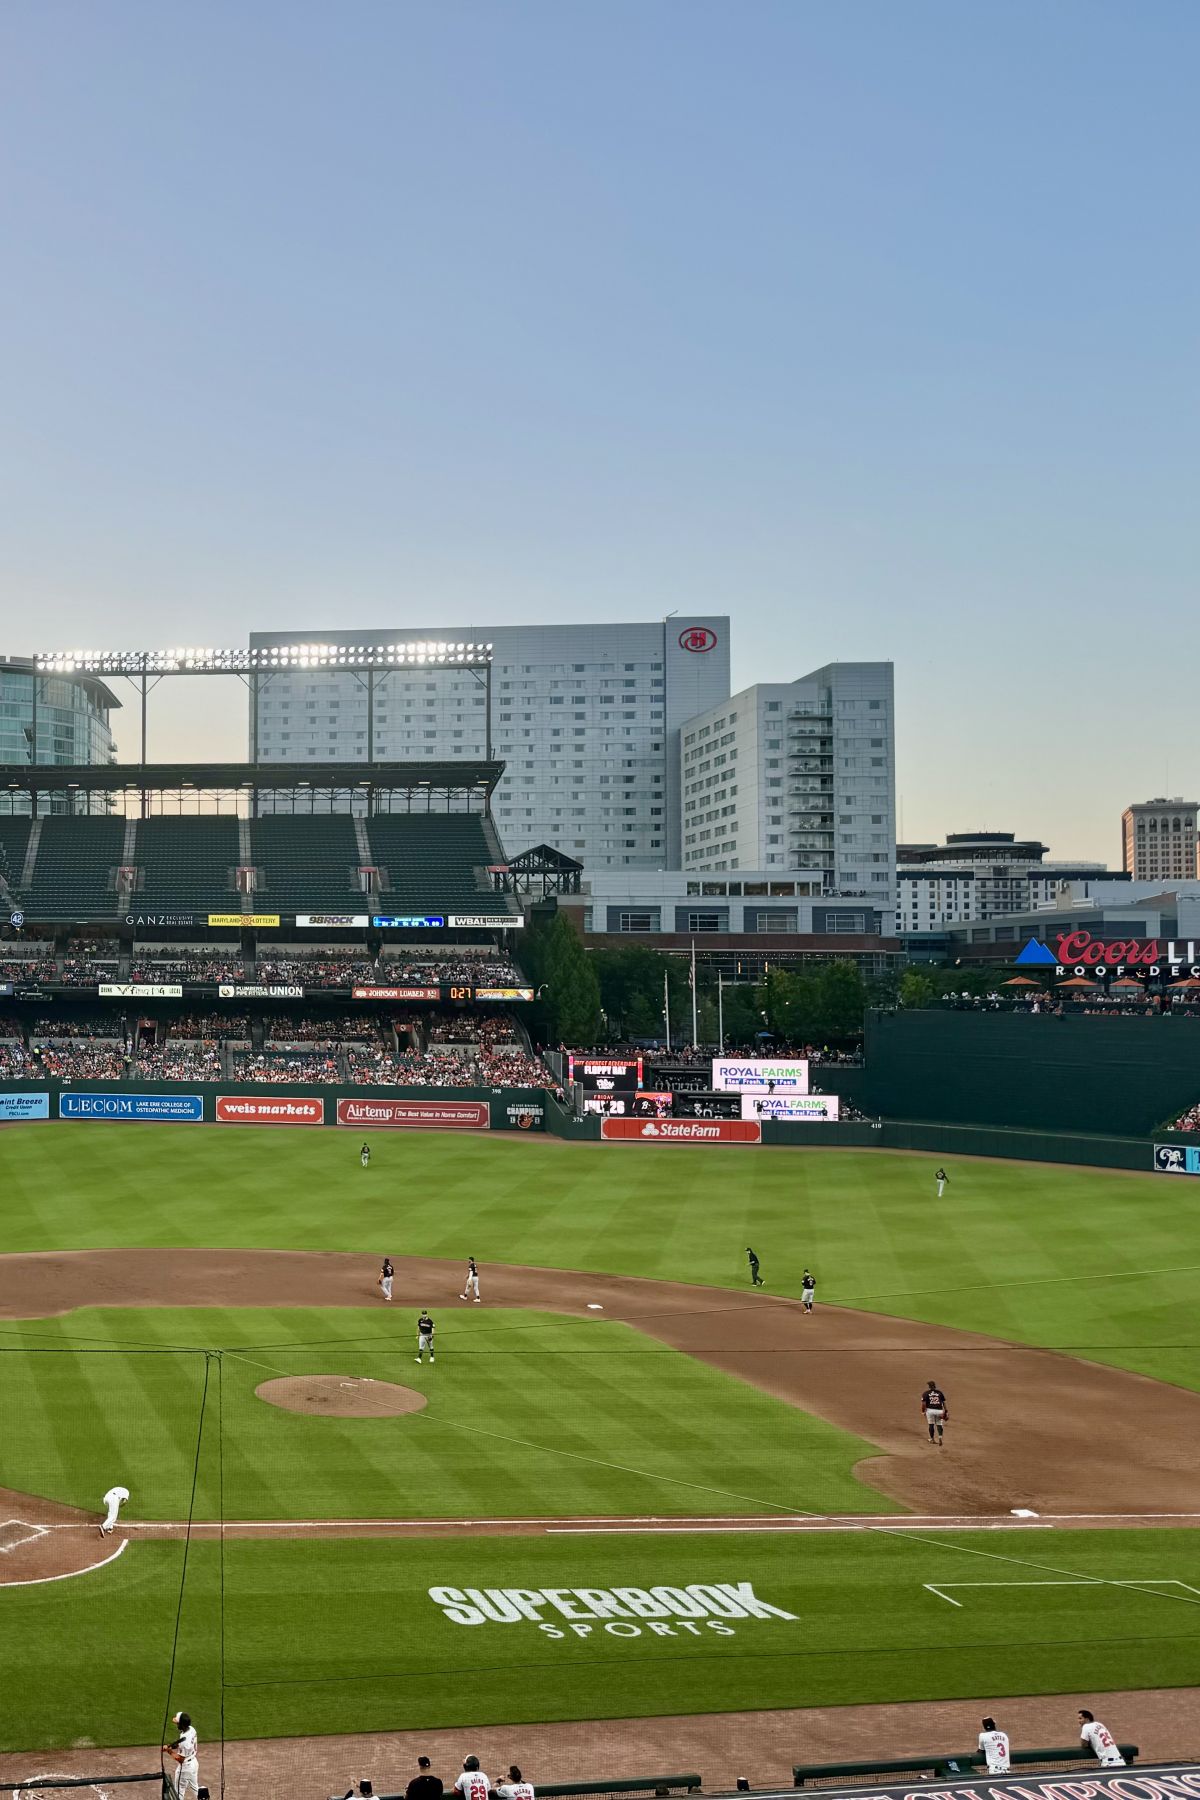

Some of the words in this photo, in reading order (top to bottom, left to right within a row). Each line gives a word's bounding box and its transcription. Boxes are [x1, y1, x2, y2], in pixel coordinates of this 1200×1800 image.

[12, 915, 22, 923] 42
[126, 916, 165, 925] GANZ
[455, 917, 486, 926] WBAL
[1056, 930, 1158, 964] Coors
[1055, 966, 1125, 976] ROOF
[270, 986, 303, 996] UNION
[399, 990, 424, 998] LUMBER
[450, 987, 471, 999] 0:27
[584, 1065, 611, 1075] FLOPPY
[612, 1066, 627, 1075] HAT
[224, 1102, 256, 1113] weis
[257, 1104, 316, 1115] markets
[347, 1104, 393, 1120] Airtemp
[506, 1107, 544, 1116] CHAMPIONS
[609, 1100, 625, 1114] 26
[428, 1582, 800, 1625] SUPERBOOK
[538, 1621, 736, 1639] SPORTS
[996, 1743, 1006, 1757] 3
[469, 1785, 487, 1800] 29
